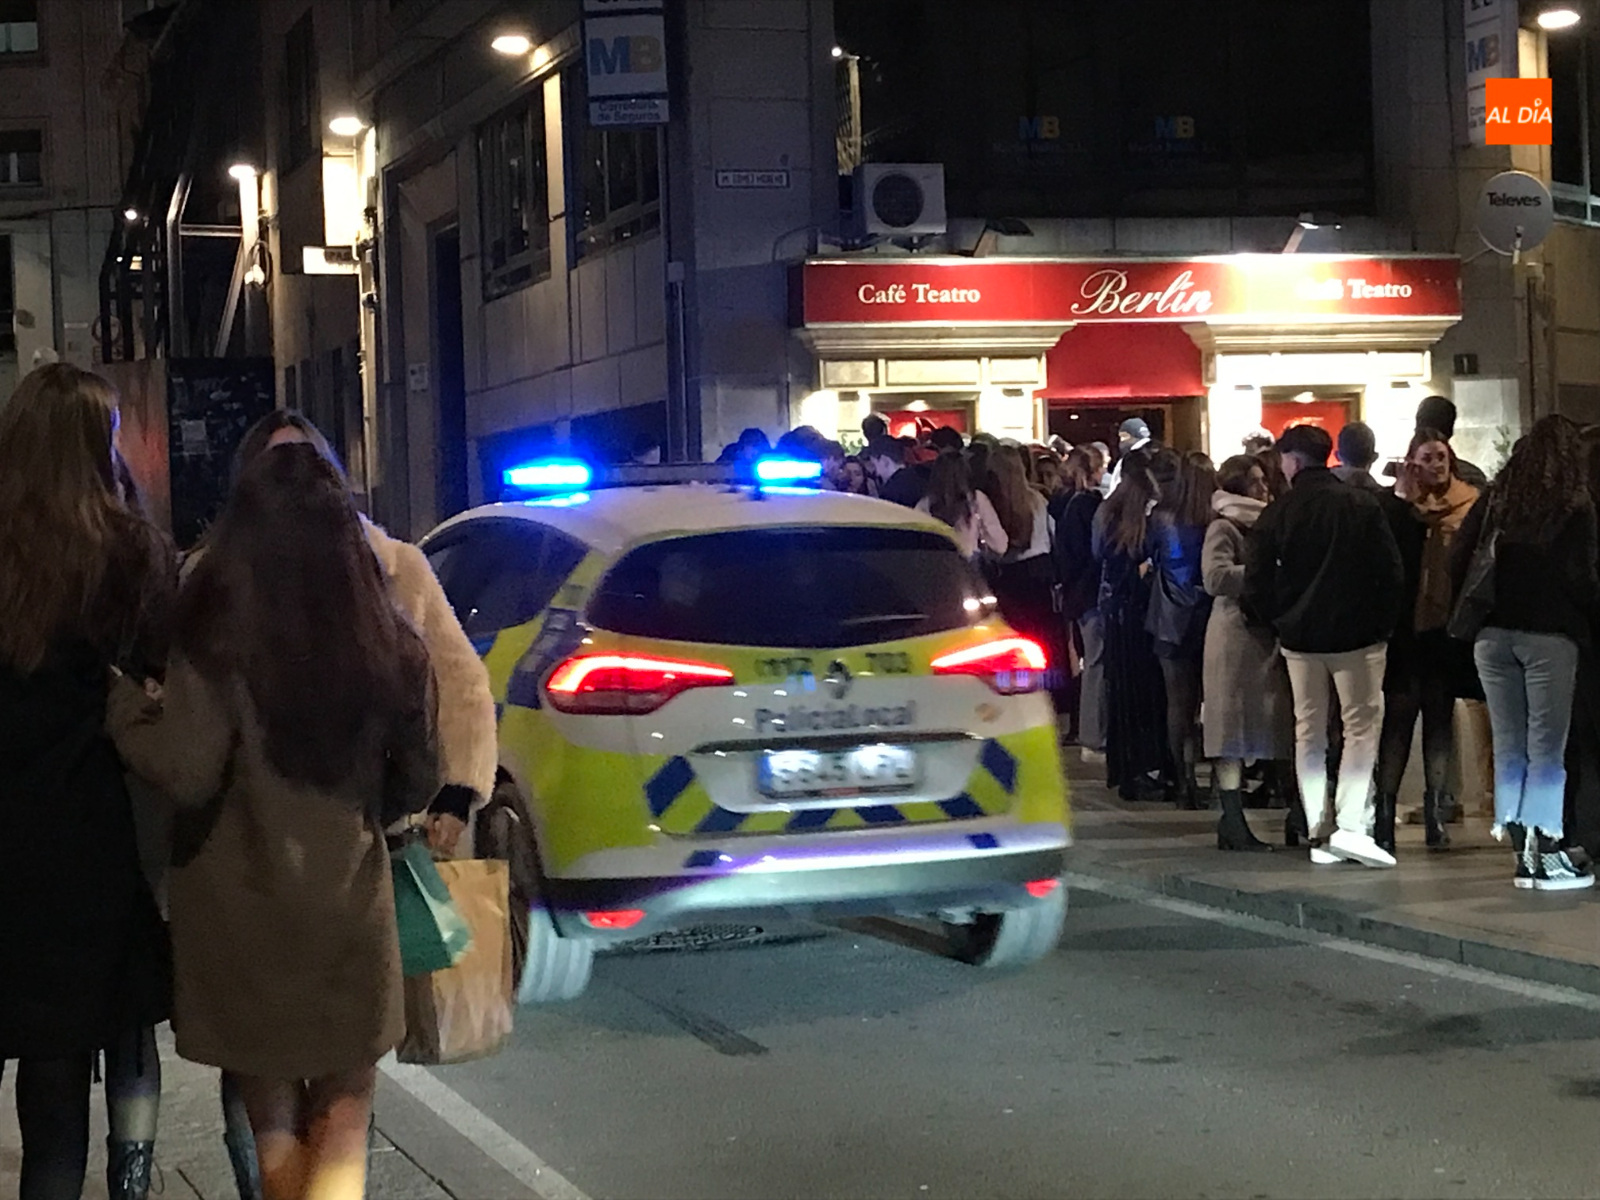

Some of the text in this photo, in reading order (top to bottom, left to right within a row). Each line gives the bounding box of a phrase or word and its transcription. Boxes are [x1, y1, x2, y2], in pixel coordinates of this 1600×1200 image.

[589, 35, 662, 76] MB
[1467, 34, 1499, 72] MB
[614, 111, 661, 124] Seguros
[1018, 115, 1061, 139] MB
[1154, 116, 1196, 139] MB
[1486, 191, 1542, 207] Televes
[857, 281, 982, 305] Café Teatro
[1070, 268, 1214, 316] Berlin
[1346, 278, 1413, 299] Teatro
